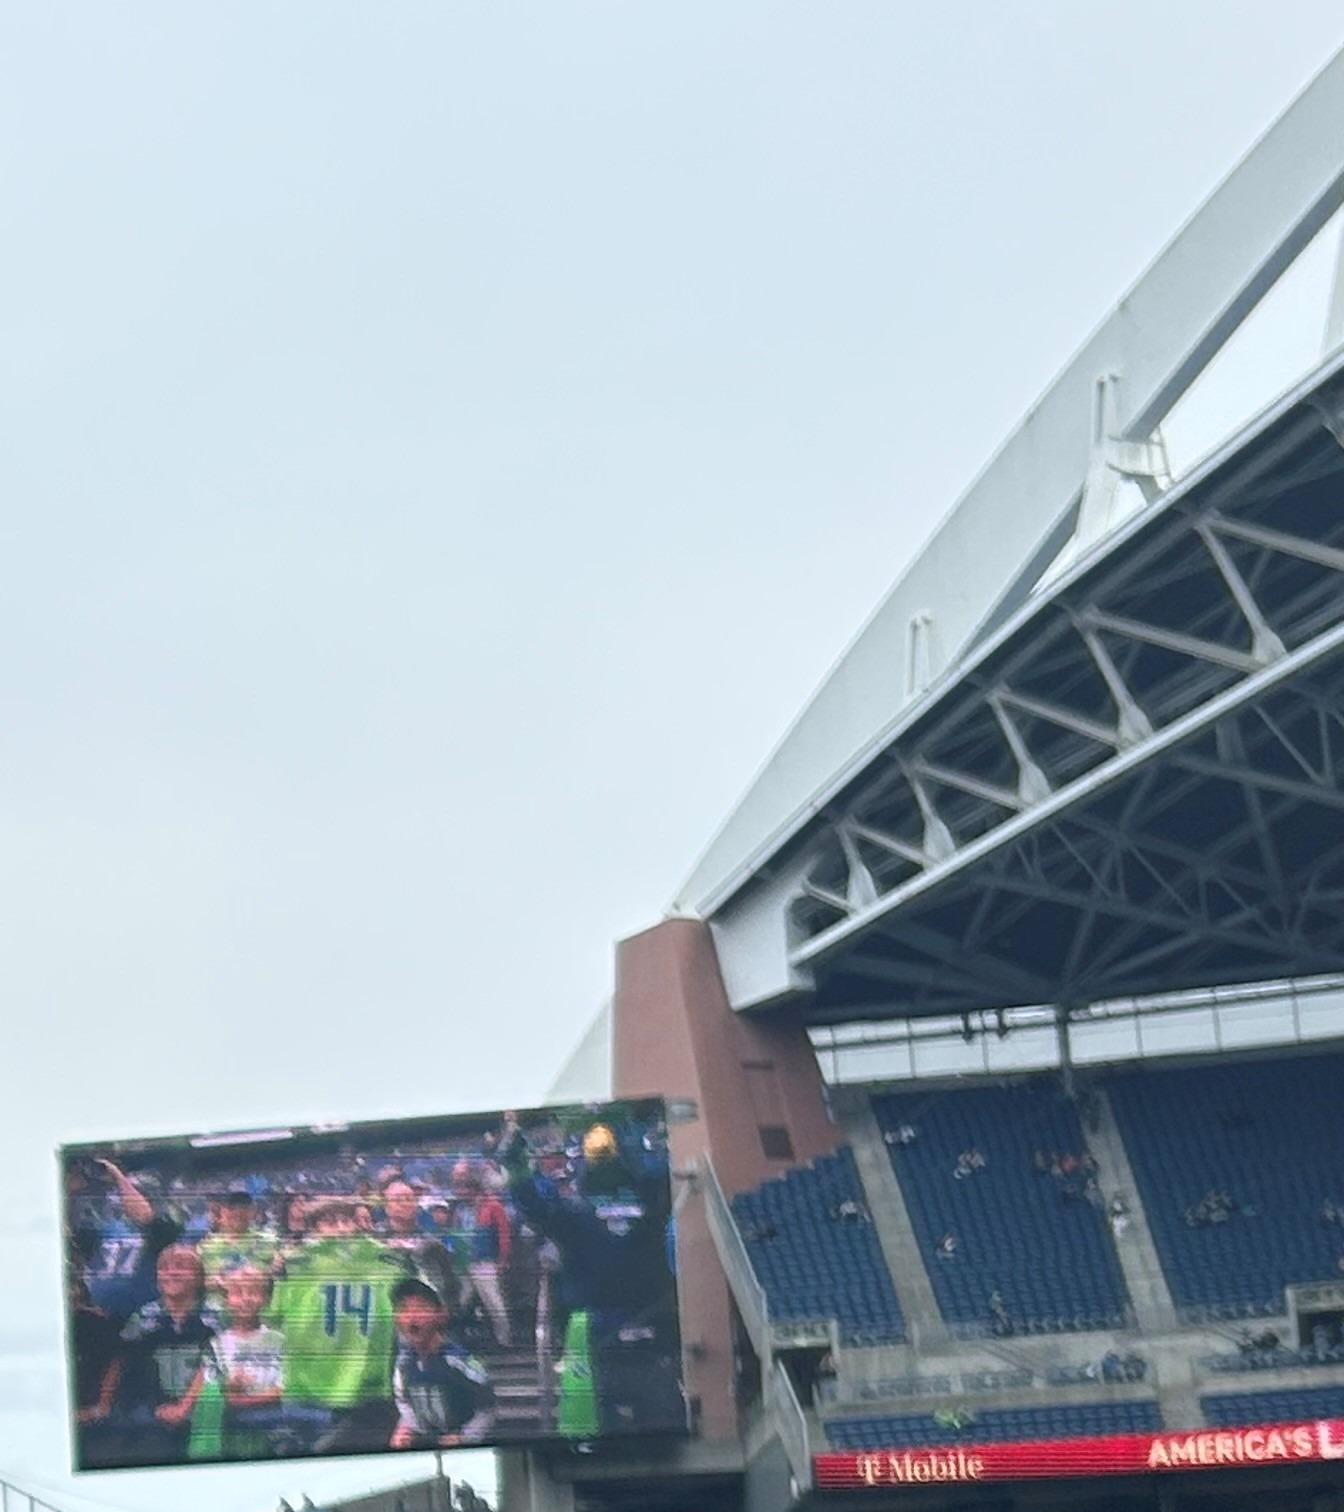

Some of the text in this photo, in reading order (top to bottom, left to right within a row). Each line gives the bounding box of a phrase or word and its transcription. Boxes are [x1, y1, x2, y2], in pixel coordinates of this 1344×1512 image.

[319, 1282, 374, 1340] 14
[1148, 1426, 1314, 1468] AMERICA'S
[887, 1453, 985, 1485] Mobile
